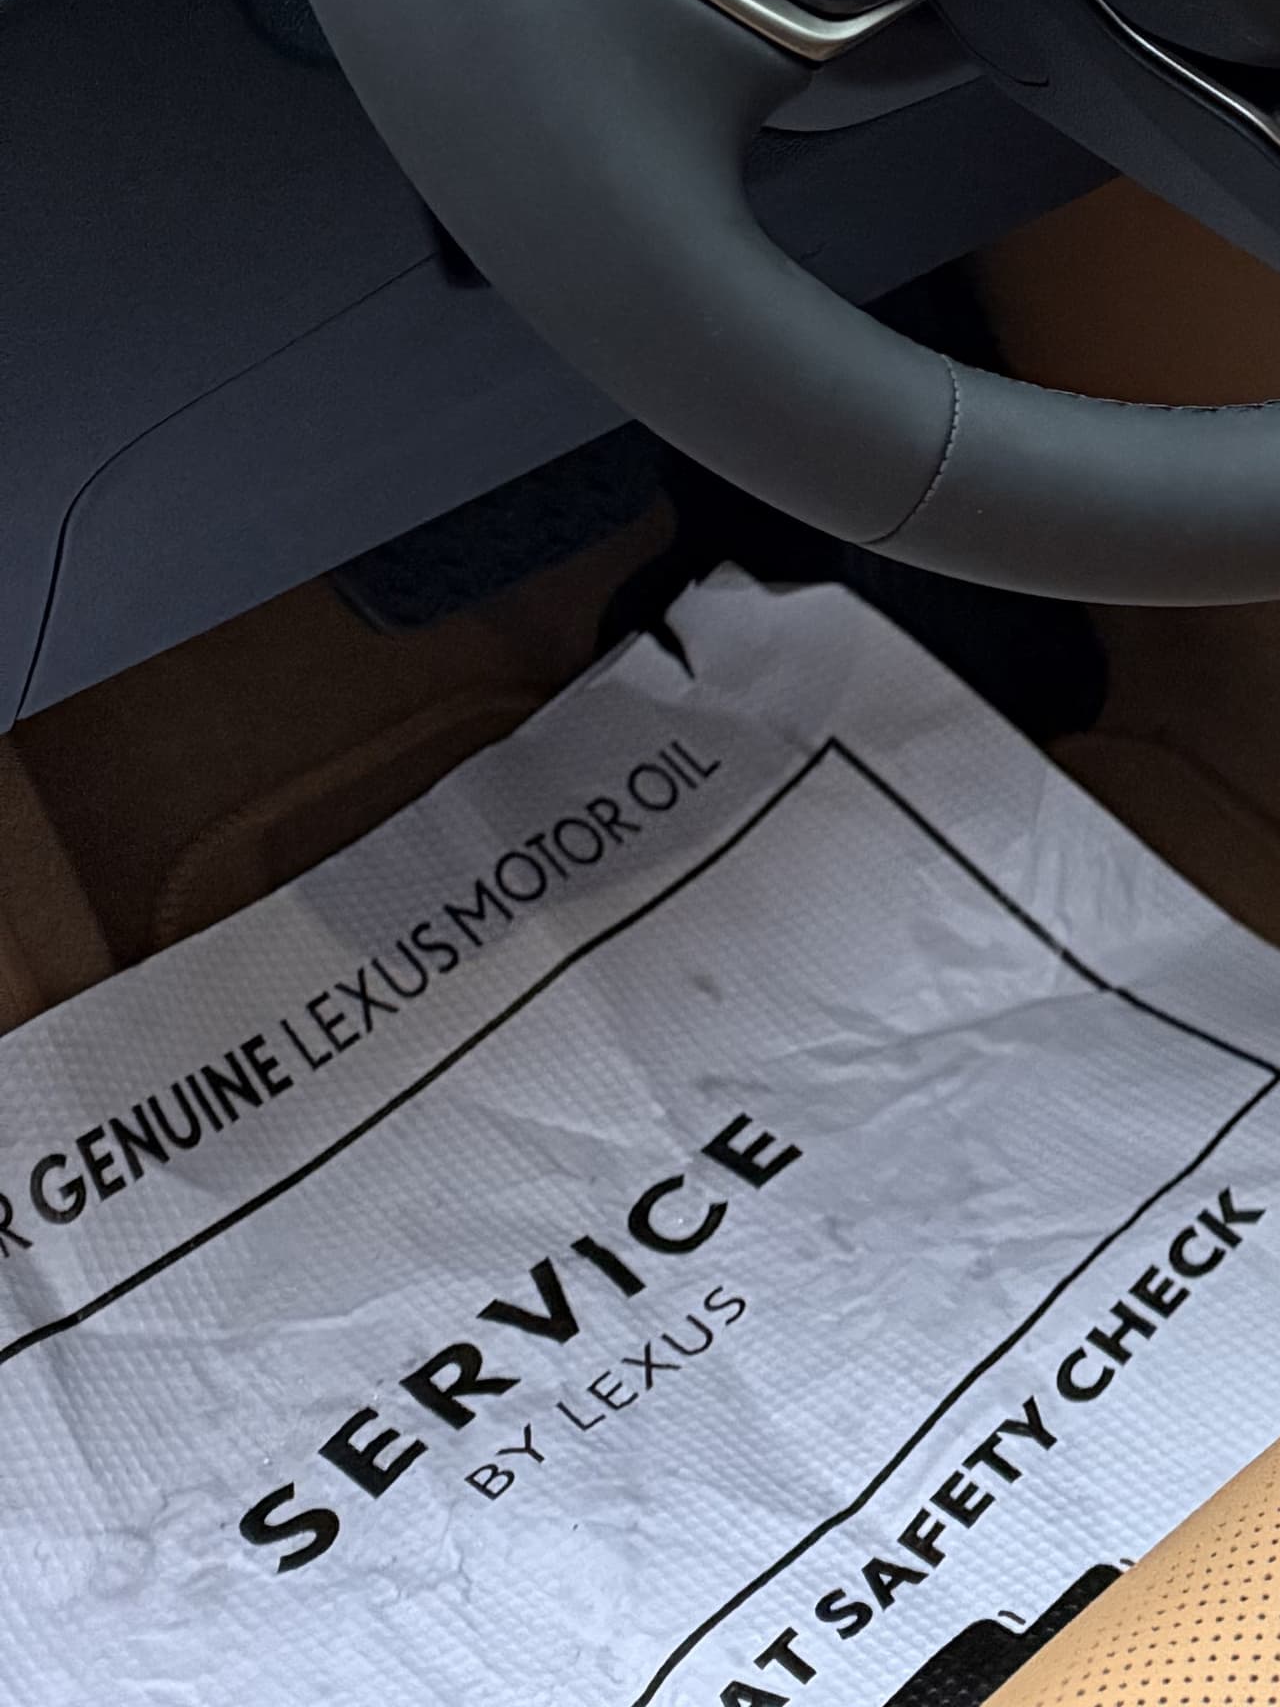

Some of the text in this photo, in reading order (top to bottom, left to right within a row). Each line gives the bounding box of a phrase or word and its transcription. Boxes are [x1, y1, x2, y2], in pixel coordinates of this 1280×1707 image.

[29, 1034, 295, 1225] GENUINE
[280, 920, 461, 1072] LEXUS
[444, 796, 642, 947] MOTOR
[627, 740, 722, 814] OIL
[239, 1113, 803, 1575] SERVICE
[464, 1285, 747, 1501] BY LEXUS
[815, 1395, 1057, 1639] SAFETY
[1056, 1187, 1266, 1402] CHECK
